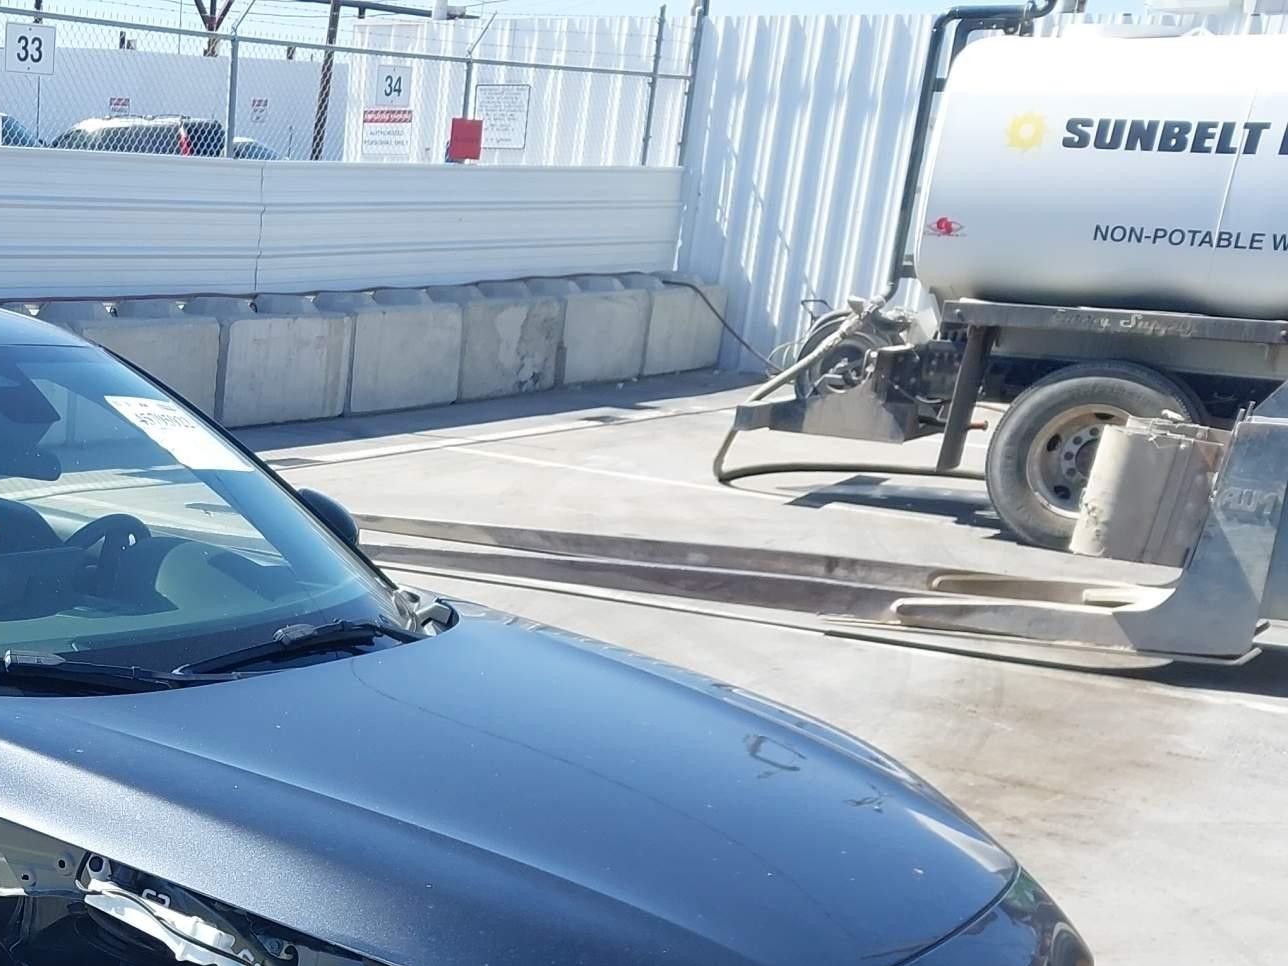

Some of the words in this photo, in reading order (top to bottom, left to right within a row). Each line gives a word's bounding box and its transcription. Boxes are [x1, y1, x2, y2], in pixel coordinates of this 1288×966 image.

[16, 35, 43, 63] 33
[383, 75, 402, 97] 34
[1062, 117, 1272, 155] SUNBELT
[1093, 224, 1265, 251] NON-POTABLE
